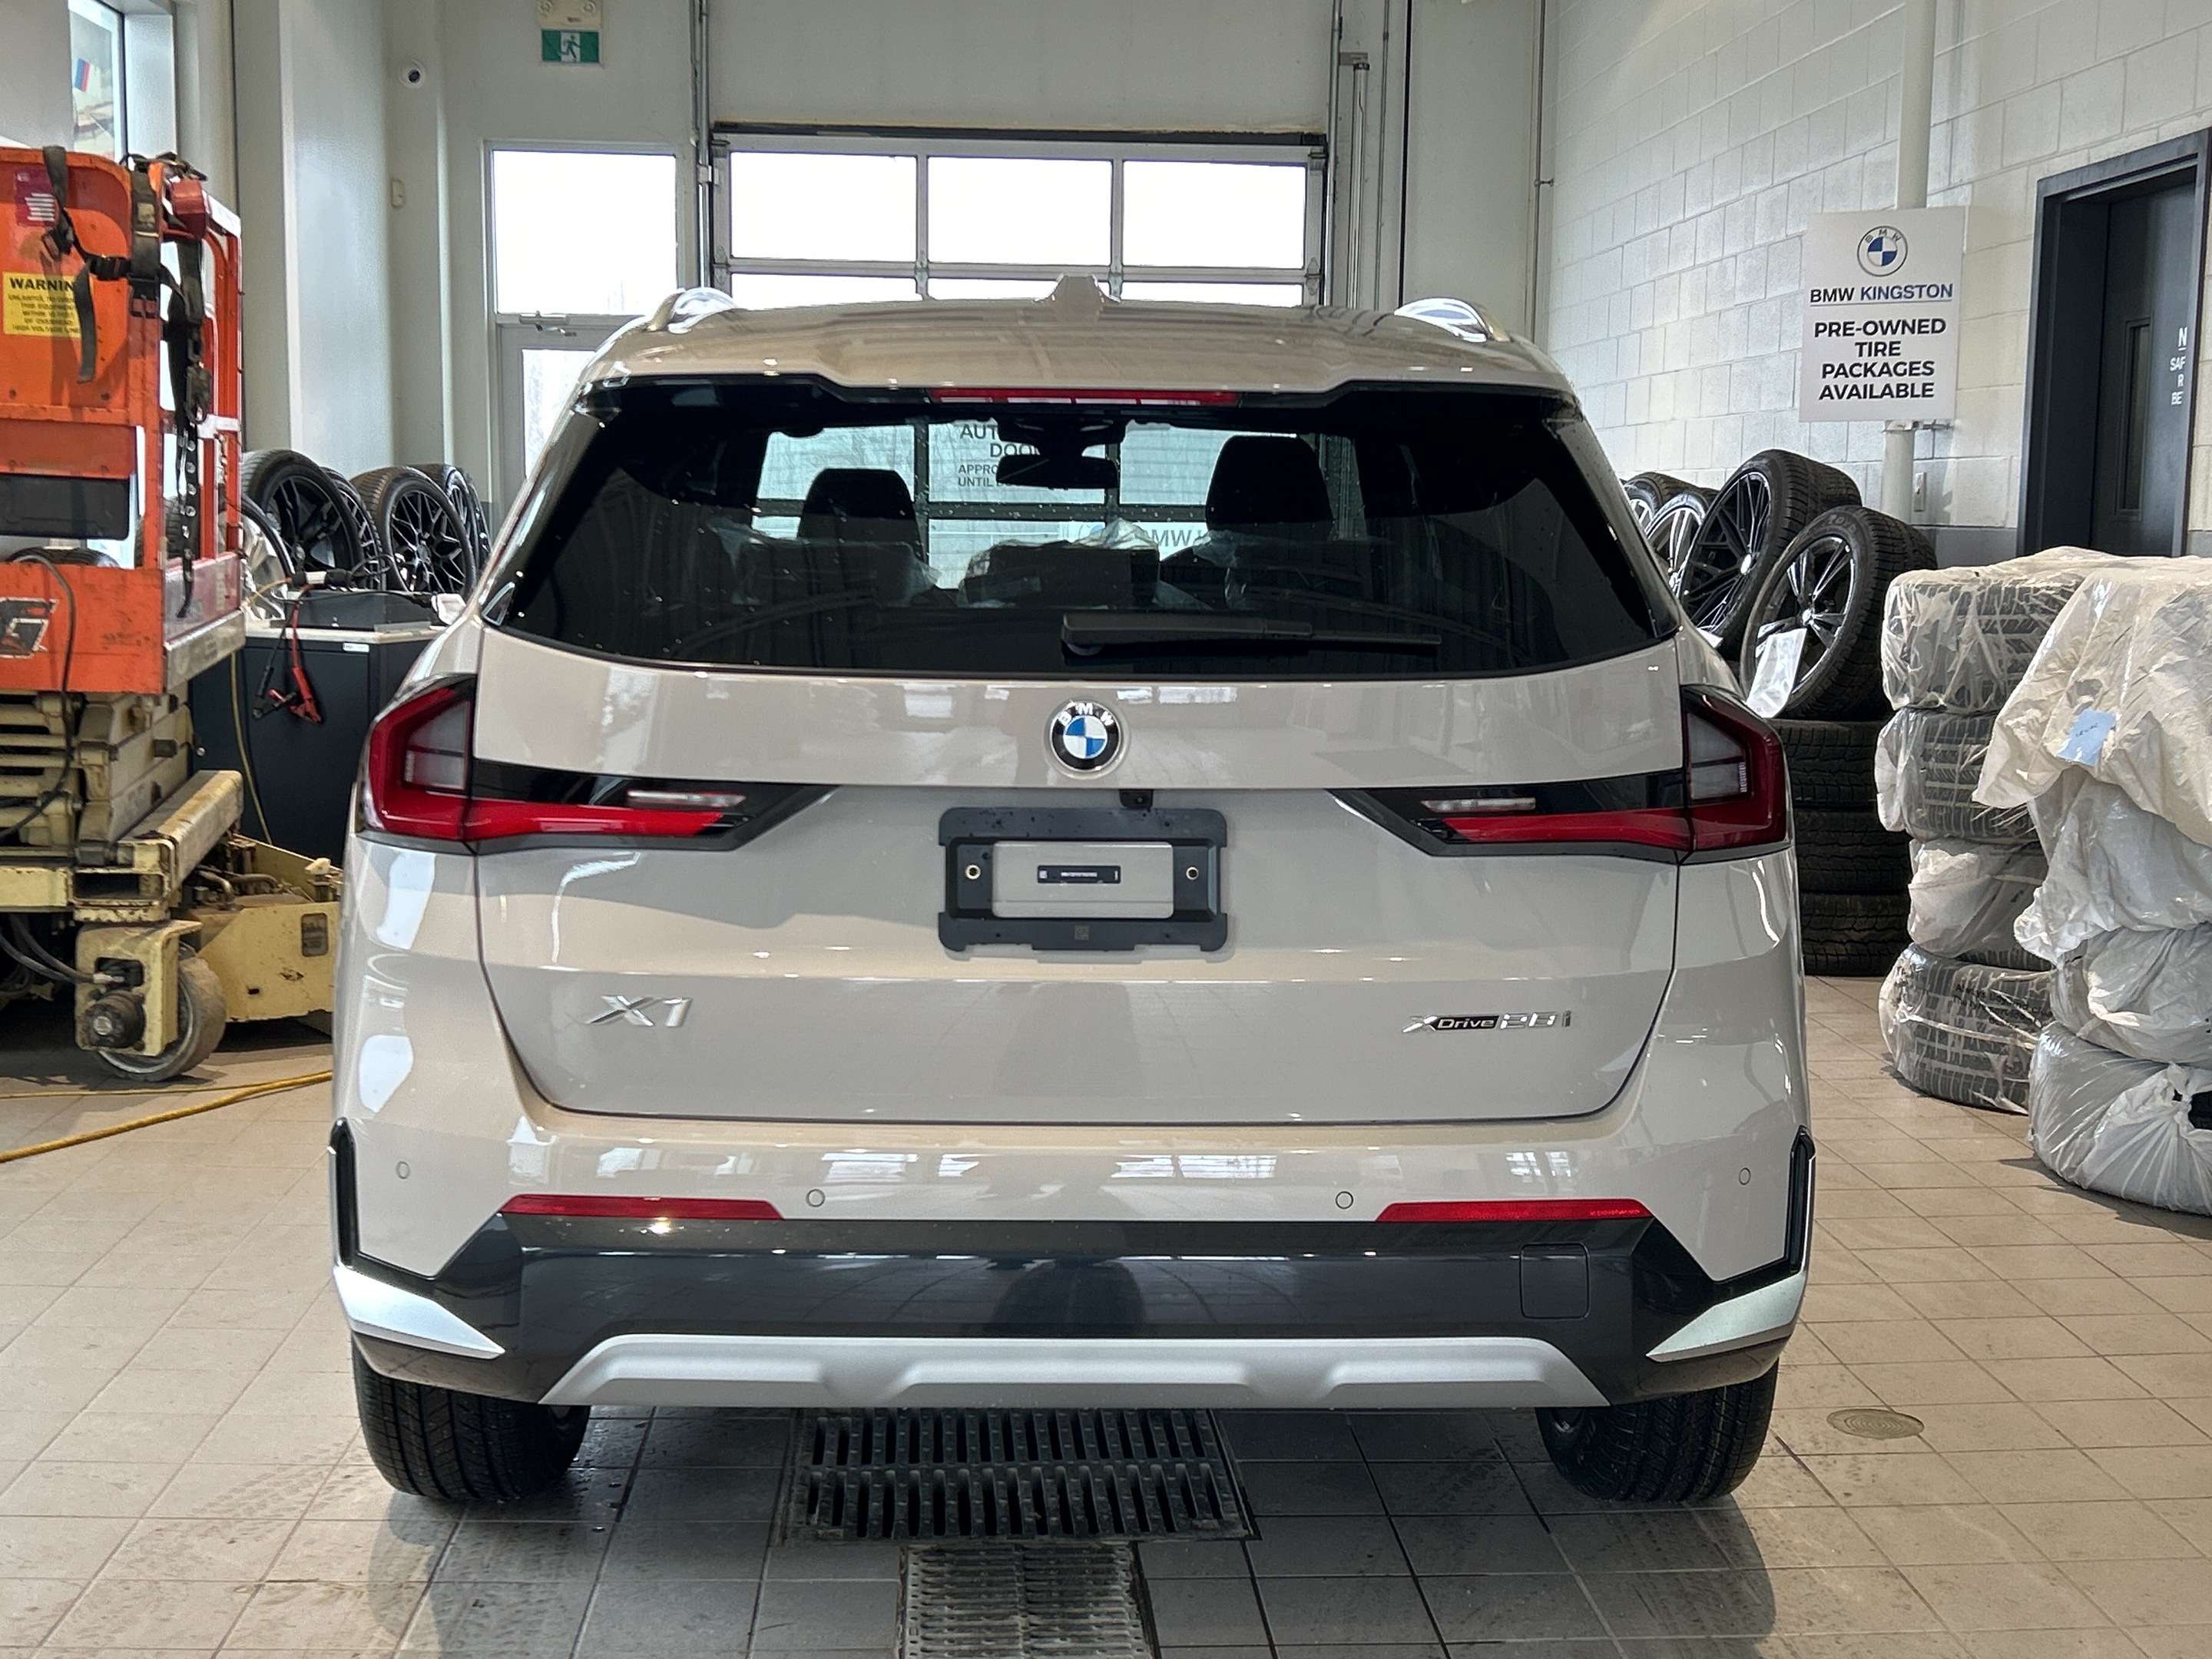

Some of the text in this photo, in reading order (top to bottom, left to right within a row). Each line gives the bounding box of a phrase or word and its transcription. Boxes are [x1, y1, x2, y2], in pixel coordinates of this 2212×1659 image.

[1865, 229, 1902, 243] BMW
[9, 277, 75, 292] WARNIN
[1810, 283, 1953, 303] BMW KINGSTON
[1815, 318, 1946, 337] PRE-OWNED
[2178, 326, 2188, 347] N
[1855, 341, 1901, 357] TIRE
[1822, 360, 1935, 379] PACKAGES
[2170, 356, 2187, 371] SAF
[1819, 382, 1935, 400] AVAILABLE
[2171, 391, 2184, 406] BE
[960, 424, 998, 439] AUT
[990, 443, 1039, 457] DOO
[959, 464, 998, 474] APPRO
[959, 477, 994, 487] UNTIL
[1151, 528, 1193, 547] MW
[1058, 702, 1114, 727] BMW
[584, 995, 694, 1027] X1
